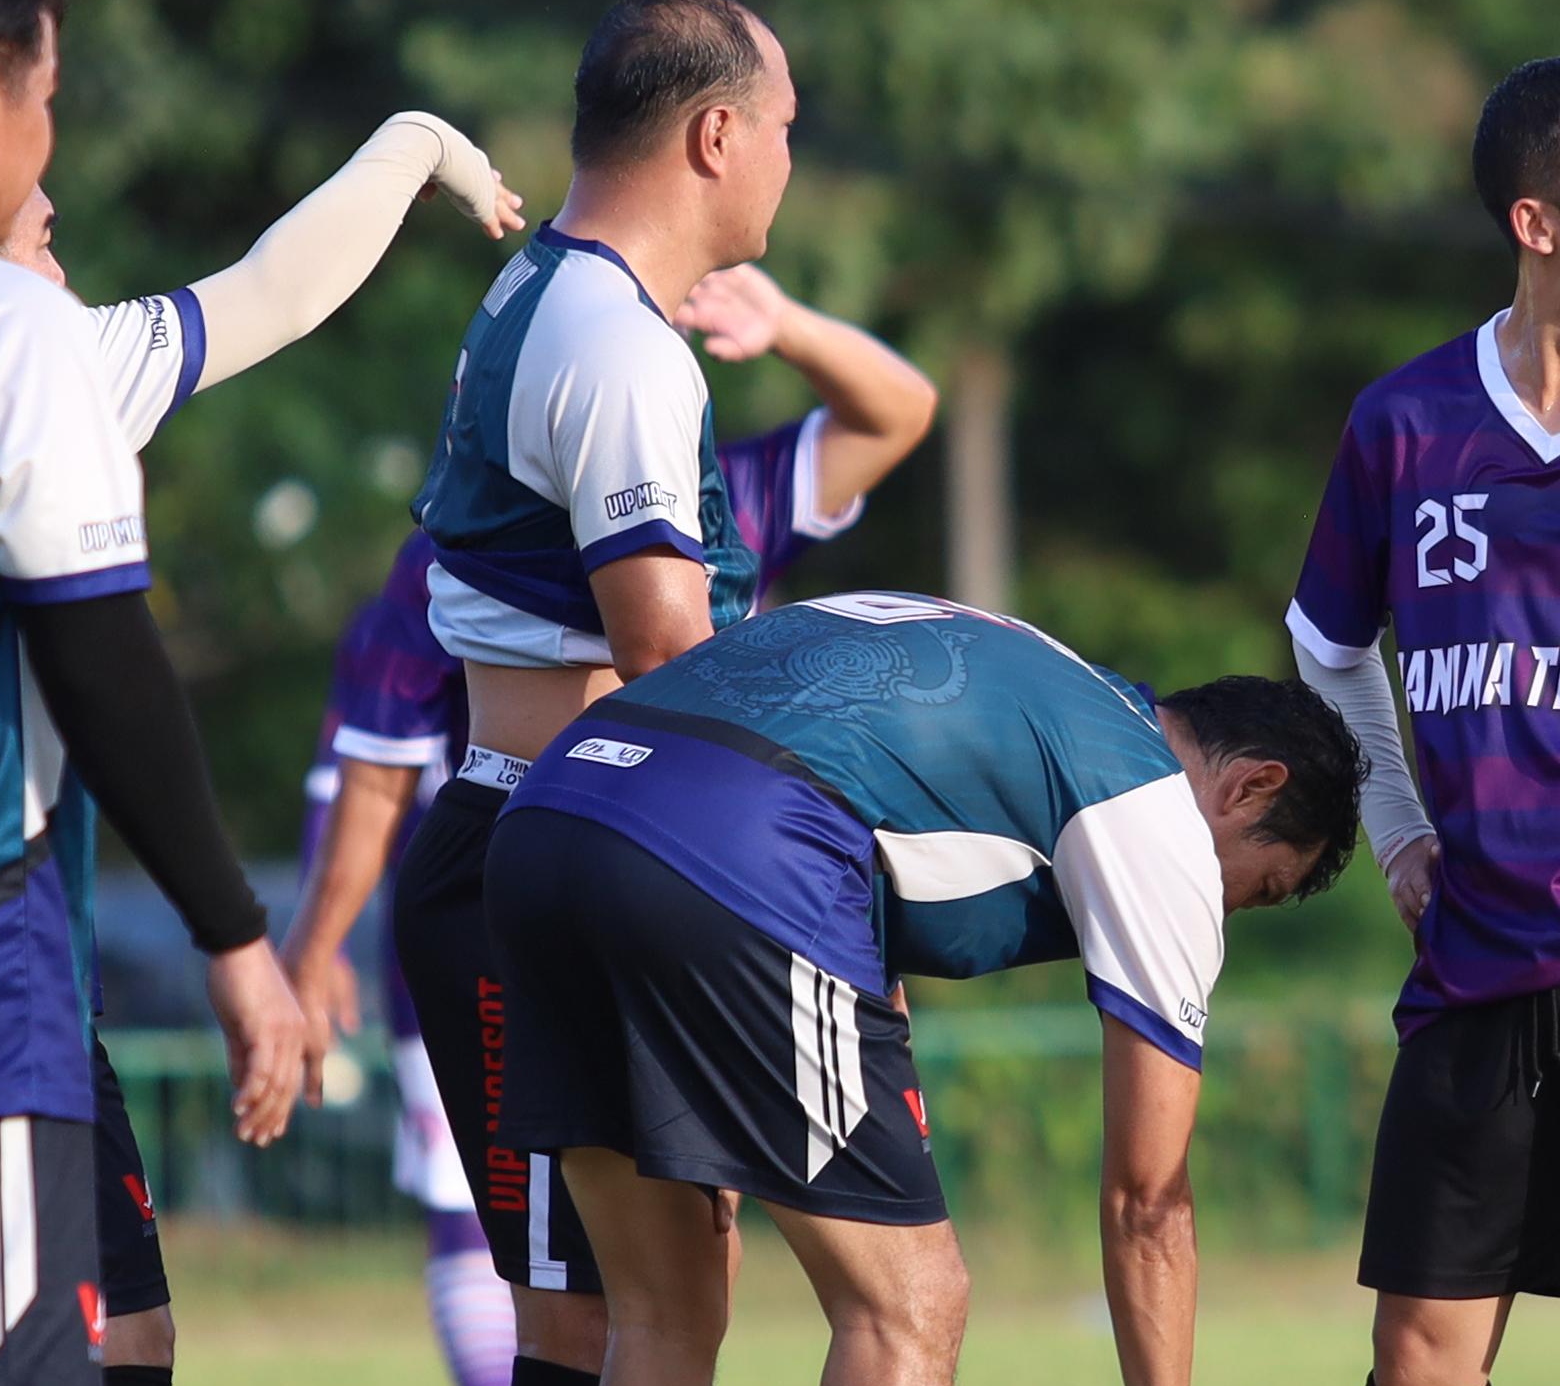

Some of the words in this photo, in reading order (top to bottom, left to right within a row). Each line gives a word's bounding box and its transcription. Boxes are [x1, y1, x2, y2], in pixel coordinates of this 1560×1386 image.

[604, 488, 636, 521] VIP
[1414, 493, 1489, 588] 25
[486, 1146, 530, 1212] VIP
